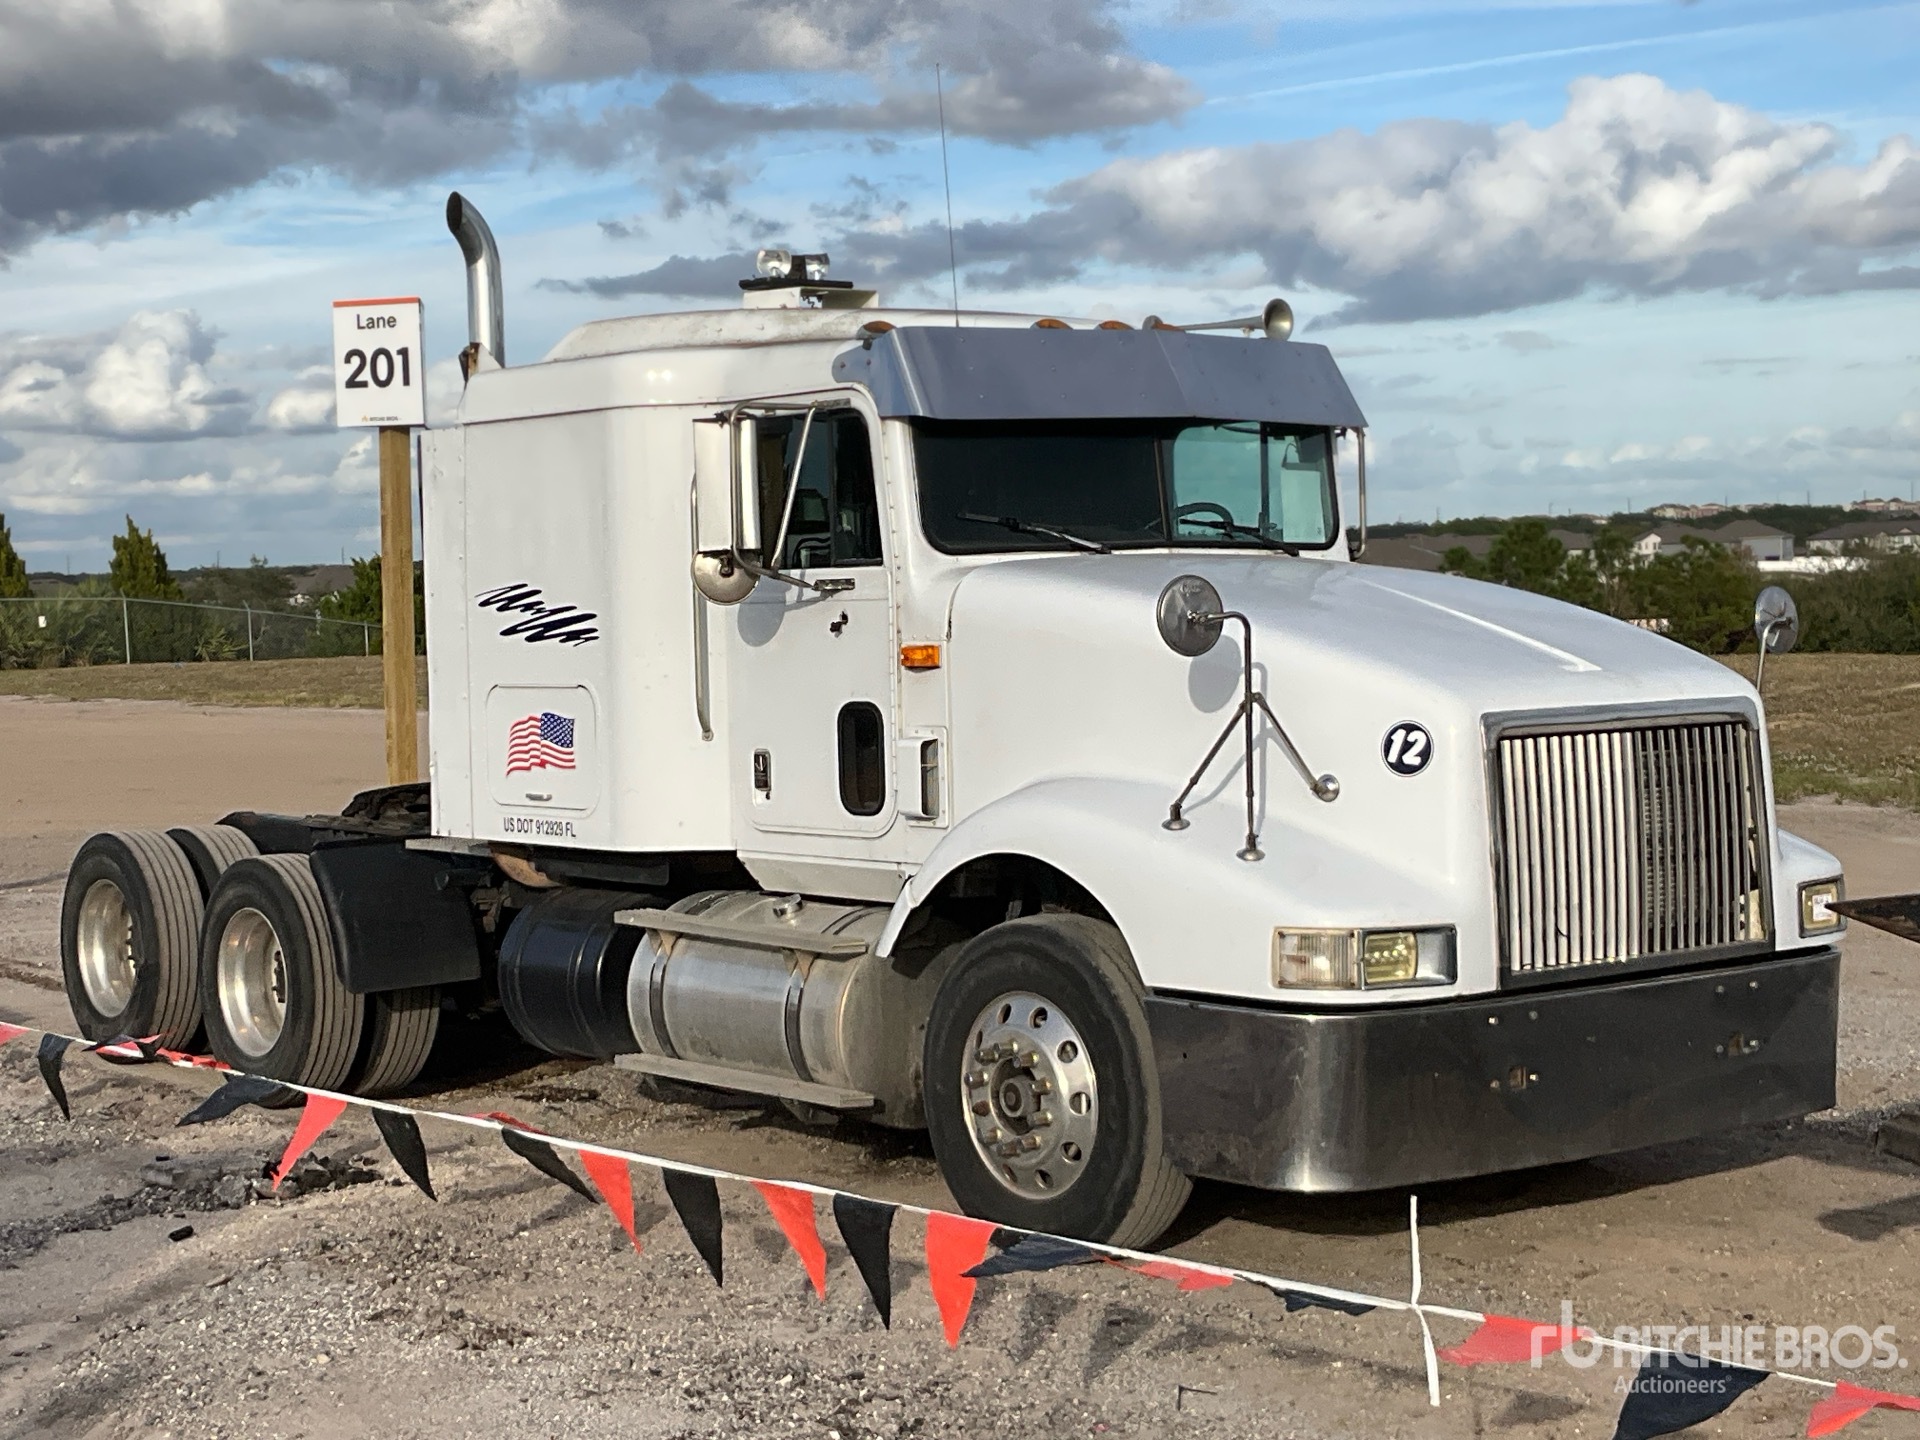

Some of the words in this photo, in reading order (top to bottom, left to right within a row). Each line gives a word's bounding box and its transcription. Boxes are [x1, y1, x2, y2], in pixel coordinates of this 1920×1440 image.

[356, 313, 397, 330] Lane
[343, 346, 411, 389] 201
[1386, 728, 1428, 766] 12
[503, 816, 515, 833] US
[516, 817, 534, 834] DOT
[535, 819, 564, 837] 912929
[565, 821, 577, 838] FL
